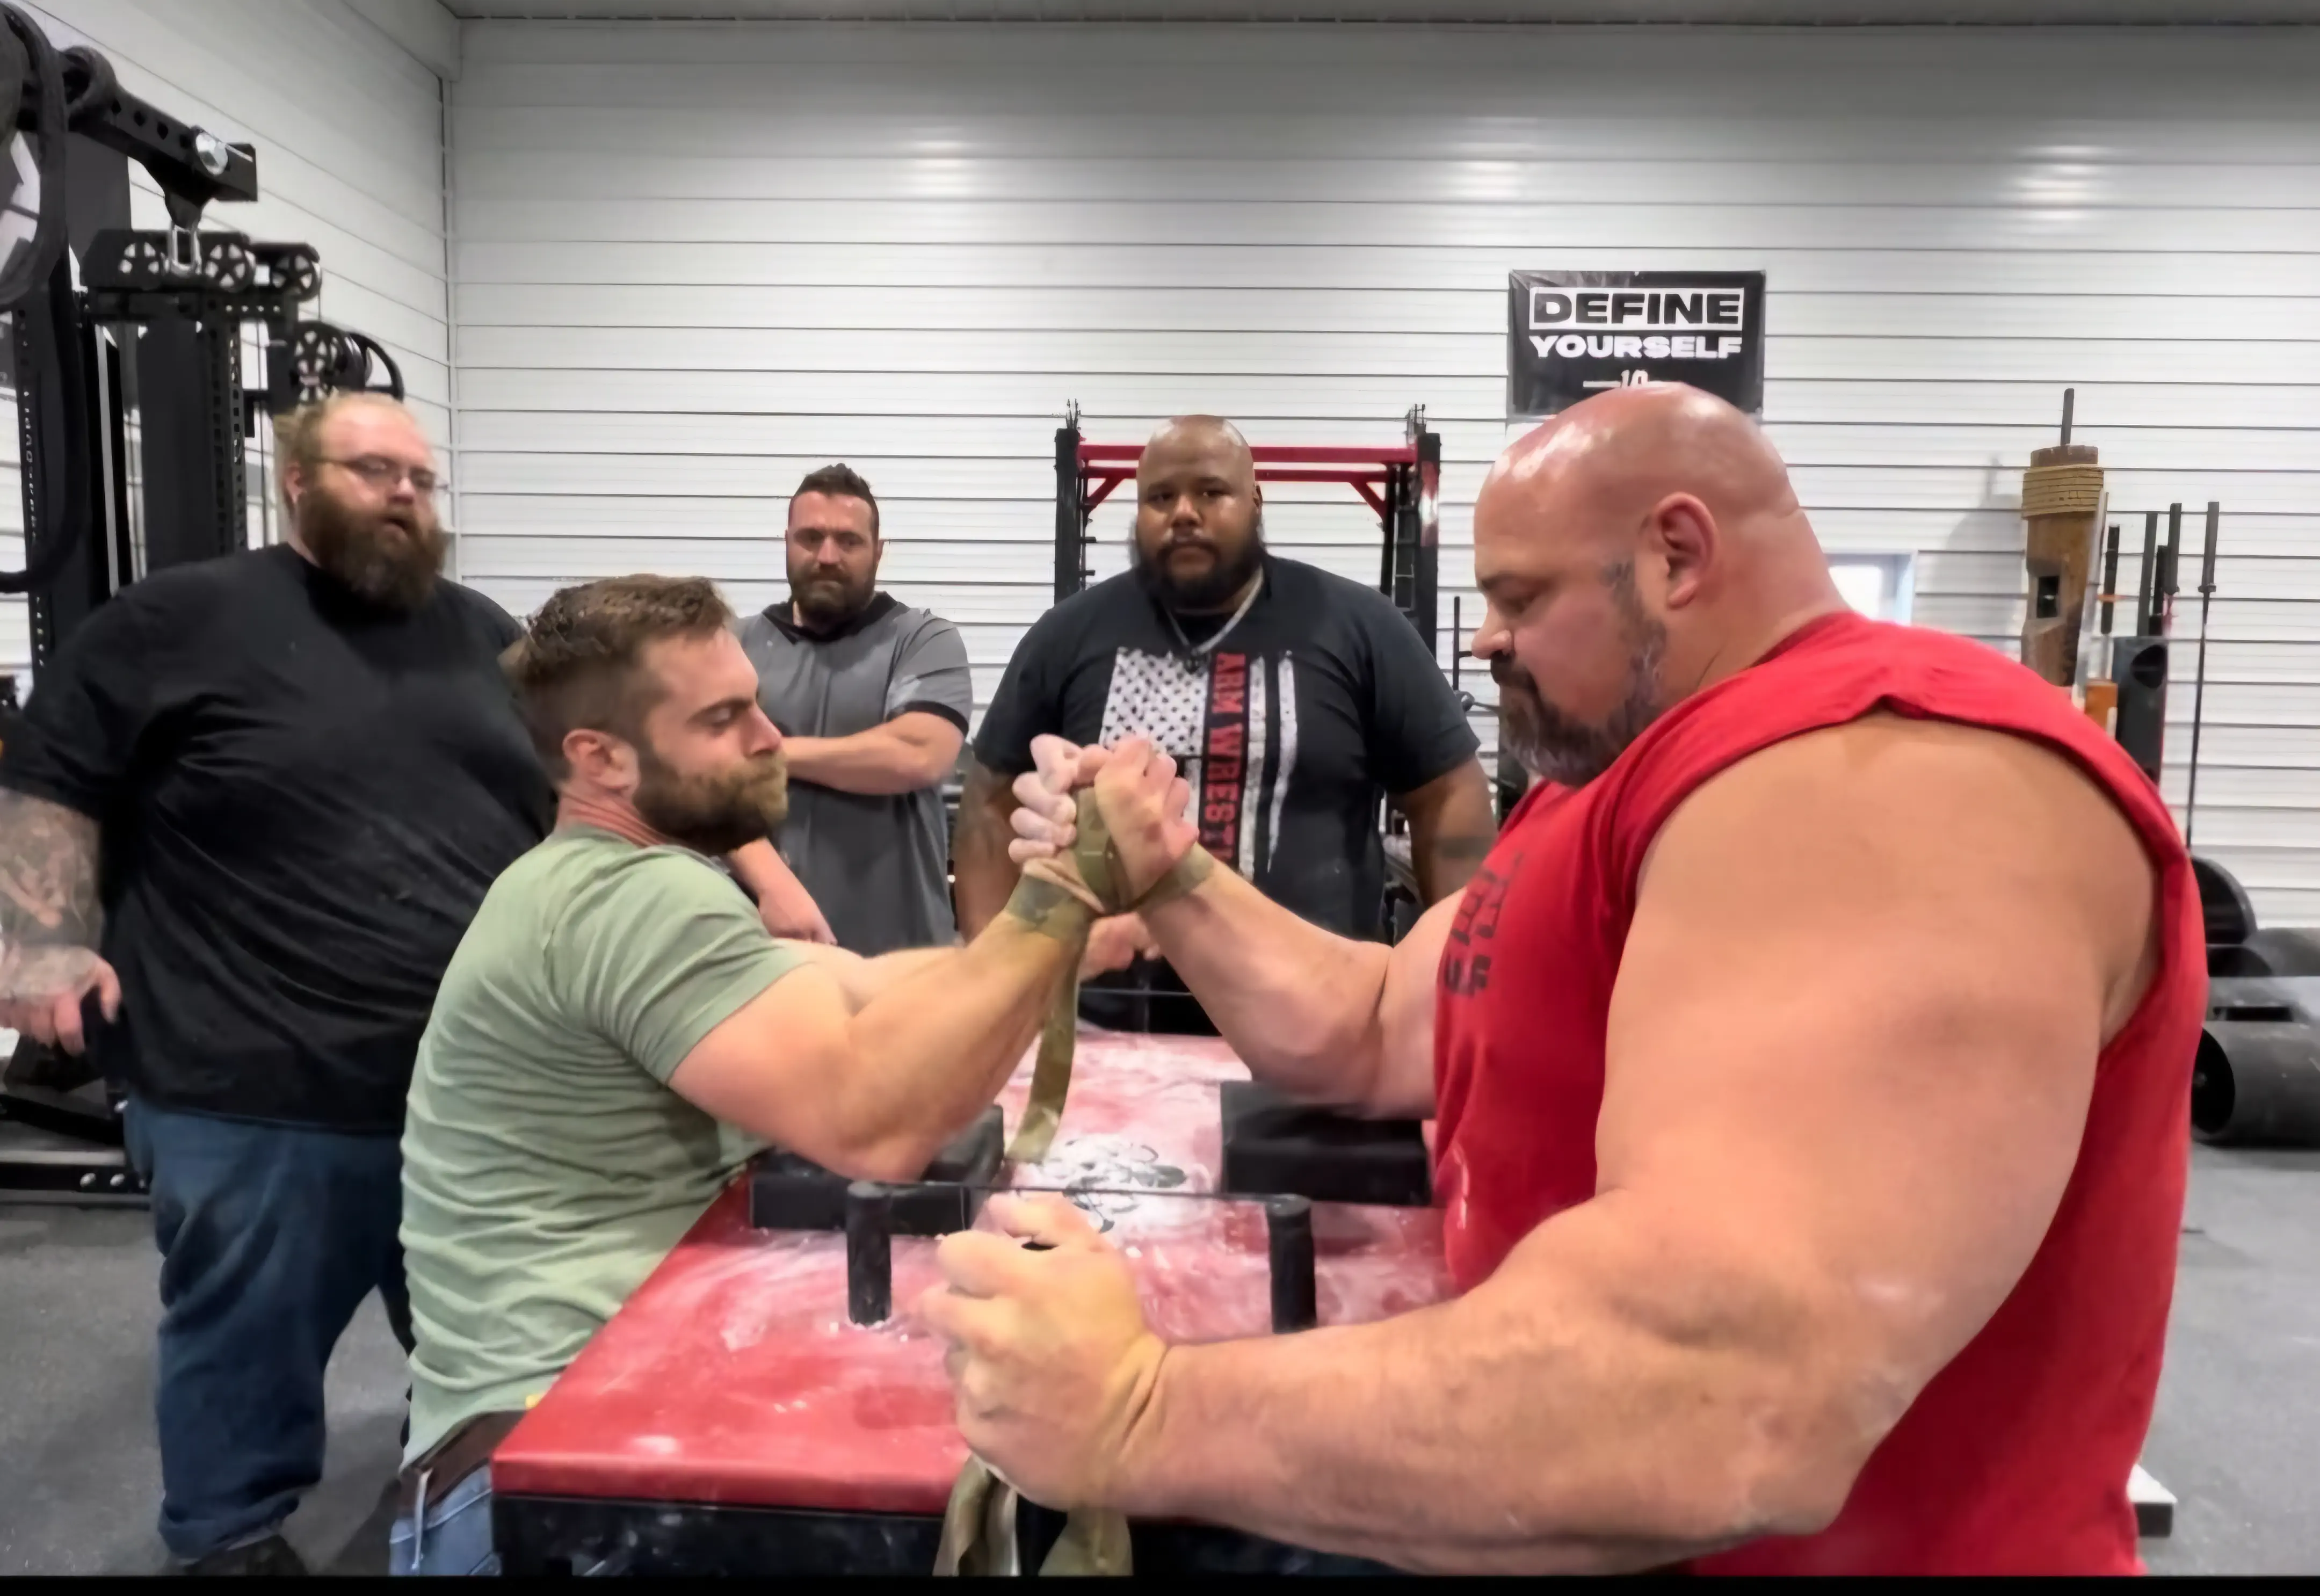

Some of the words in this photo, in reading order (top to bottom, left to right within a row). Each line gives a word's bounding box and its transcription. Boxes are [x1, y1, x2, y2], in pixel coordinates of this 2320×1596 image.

[1534, 293, 1741, 325] DEFINE
[1529, 334, 1743, 359] YOURSELF
[1212, 652, 1246, 714] ARM
